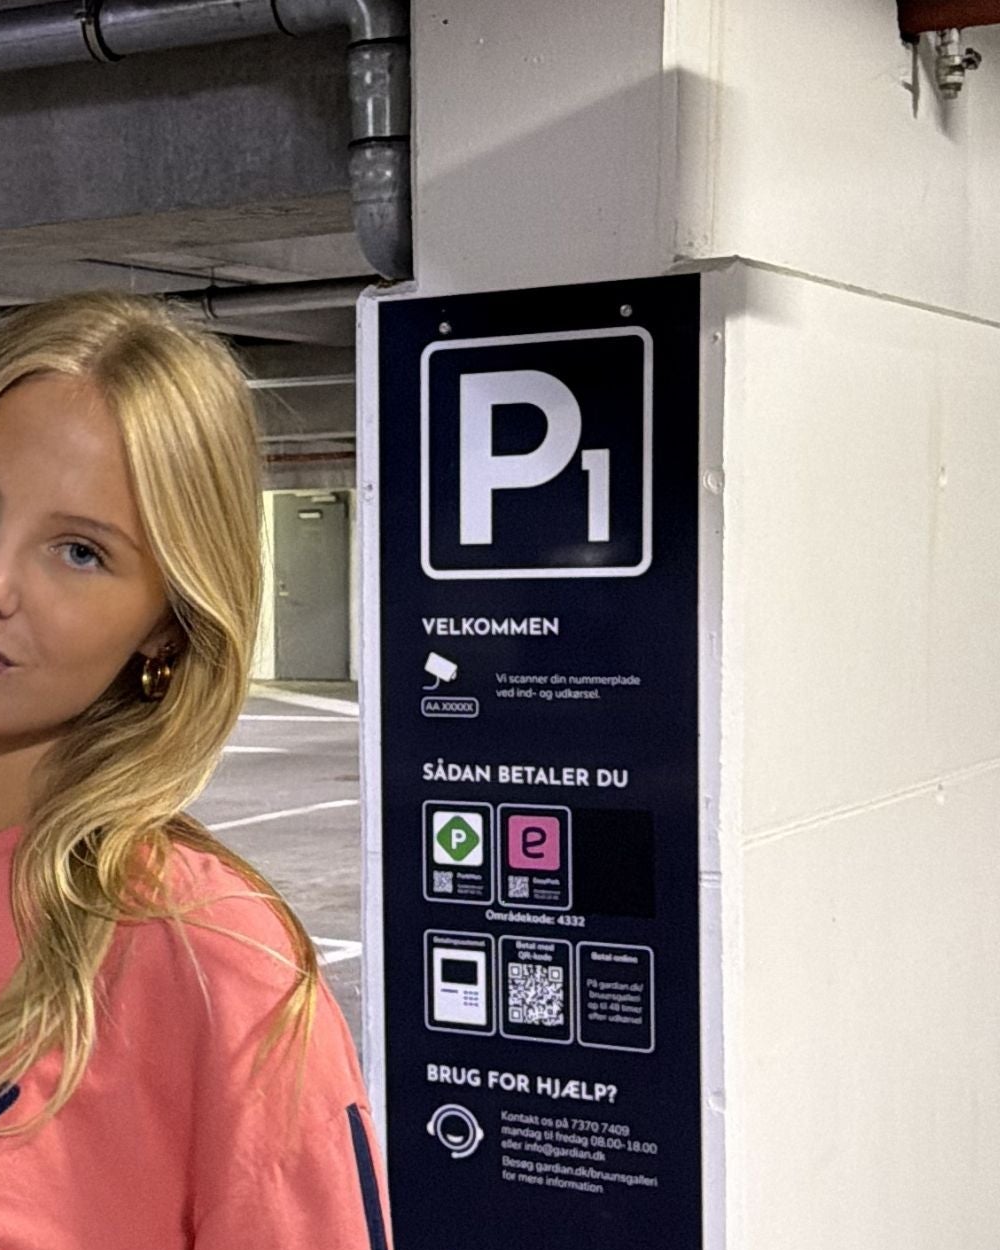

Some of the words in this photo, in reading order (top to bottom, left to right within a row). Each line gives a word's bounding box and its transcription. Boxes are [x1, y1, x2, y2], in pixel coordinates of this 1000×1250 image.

[460, 369, 610, 545] P1
[422, 617, 559, 635] VELKOMMEN
[496, 673, 507, 684] Vi
[509, 675, 548, 684] scanner
[550, 674, 567, 684] din
[569, 674, 641, 687] nummerplade
[496, 688, 515, 698] ved
[517, 688, 536, 698] ind-
[539, 690, 553, 700] og
[555, 689, 601, 699] udkørsel.
[426, 702, 440, 711] AA
[422, 758, 491, 782] SÅDAN
[498, 765, 590, 787] BETALER
[597, 769, 629, 788] DU
[485, 909, 555, 925] Områdekode:
[557, 915, 585, 927] 4332
[427, 1063, 481, 1087] BRUG
[487, 1070, 530, 1093] FOR
[536, 1076, 618, 1103] HJÆLP?
[501, 1111, 539, 1125] Kontakt
[541, 1118, 553, 1127] os
[555, 1117, 569, 1129] på
[571, 1119, 599, 1133] 7370
[601, 1122, 630, 1136] 7409
[501, 1125, 542, 1141] mandag
[544, 1131, 553, 1140] til
[555, 1132, 588, 1147] fredag
[501, 1139, 522, 1149] eller
[524, 1142, 606, 1161] info@gardian.dk
[502, 1155, 534, 1171] Besøg
[502, 1170, 516, 1180] for
[518, 1174, 543, 1185] mere
[546, 1176, 604, 1193] information
